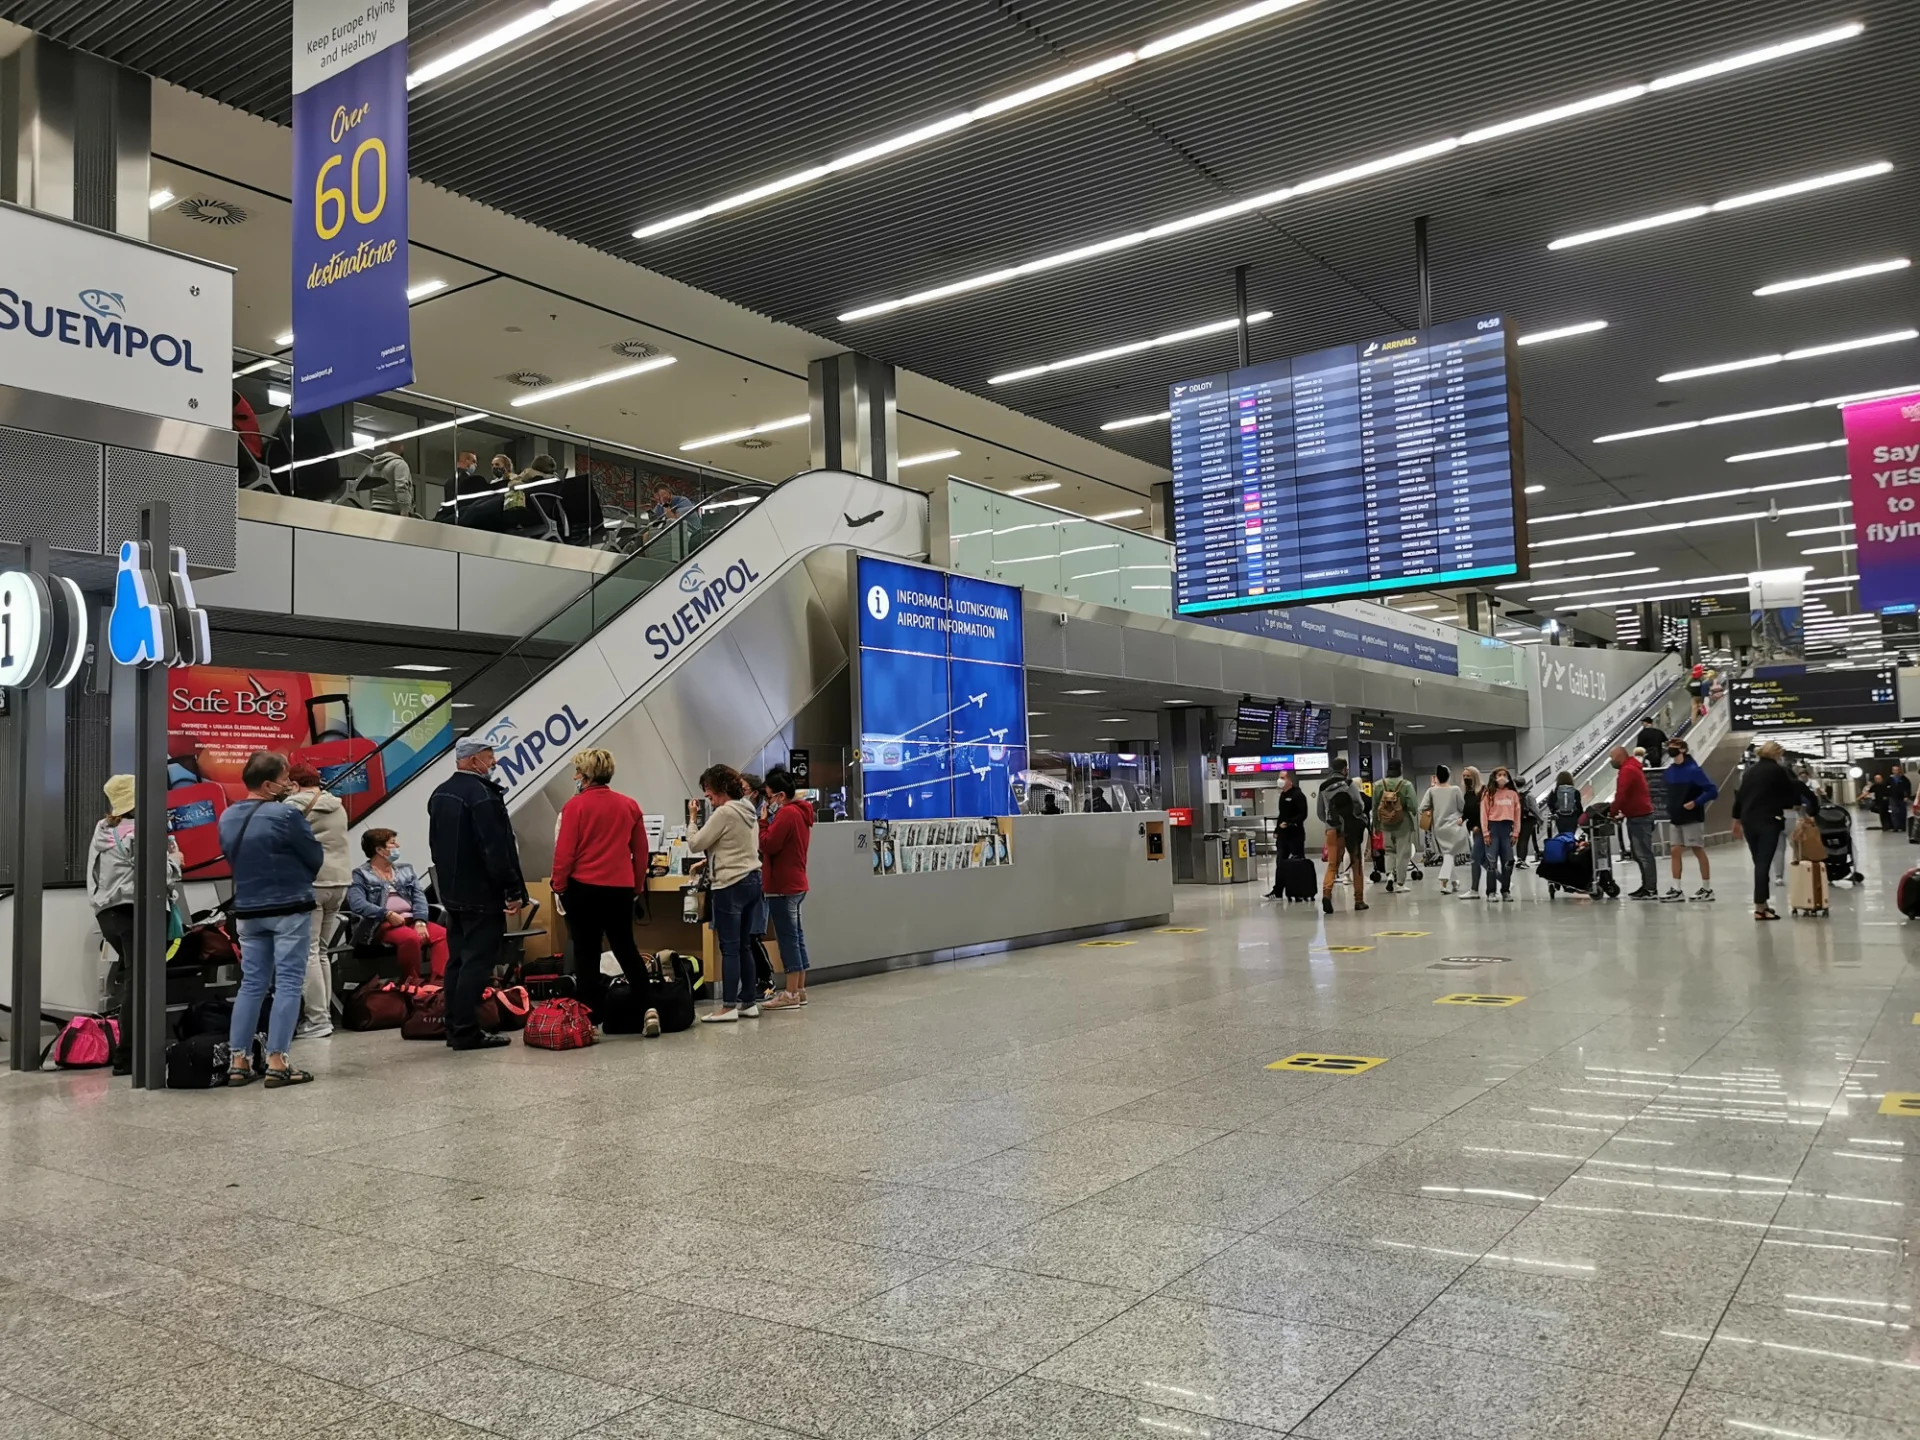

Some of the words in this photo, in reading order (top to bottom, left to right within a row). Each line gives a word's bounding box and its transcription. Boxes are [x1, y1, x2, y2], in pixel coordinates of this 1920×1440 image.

[307, 35, 329, 54] Keep
[332, 15, 363, 41] Europe
[367, 0, 395, 21] Flying
[320, 47, 338, 68] and
[341, 29, 377, 57] Healthy
[330, 102, 370, 143] Over
[315, 137, 387, 240] 60
[306, 238, 397, 290] destinations
[0, 287, 203, 374] SUEMPOL
[1381, 336, 1417, 351] ARRIVALS
[380, 344, 405, 358] ryanair.com
[1189, 381, 1213, 393] ODLOTY
[1872, 444, 1920, 463] Say
[1872, 466, 1920, 489] YES
[1887, 496, 1915, 513] to
[645, 558, 759, 660] SUEMPOL
[896, 589, 954, 612] INFORMACJA
[956, 599, 1009, 621] LOTNISKOWA
[897, 611, 935, 630] AIRPORT
[937, 618, 995, 640] INFORMATION
[1283, 621, 1293, 631] there
[1568, 663, 1589, 698] Gate
[1589, 669, 1607, 702] 1-18
[171, 687, 230, 714] Safe
[233, 690, 288, 721] Bag
[392, 691, 419, 708] WE
[1752, 712, 1778, 720] Check-in
